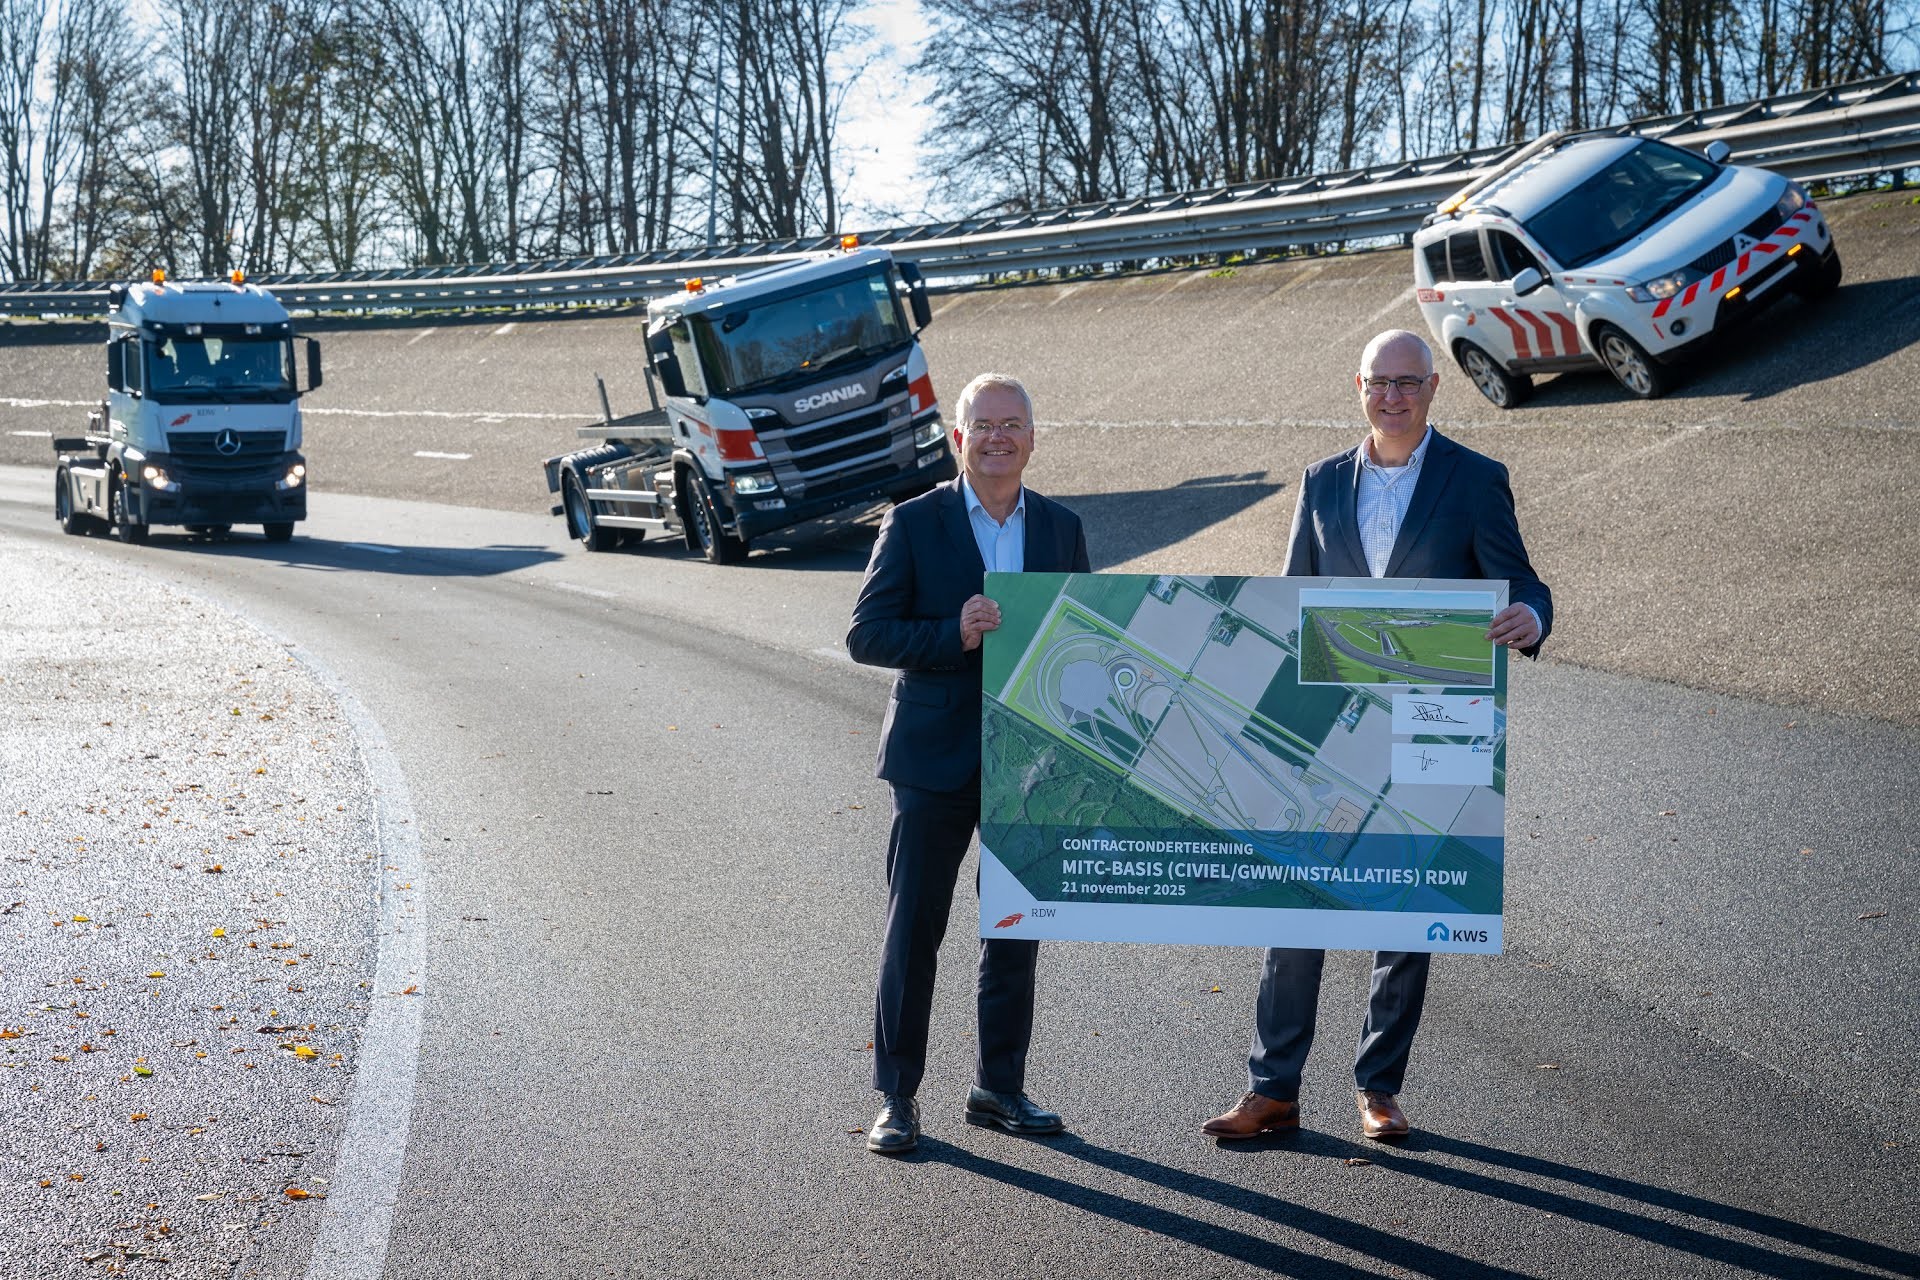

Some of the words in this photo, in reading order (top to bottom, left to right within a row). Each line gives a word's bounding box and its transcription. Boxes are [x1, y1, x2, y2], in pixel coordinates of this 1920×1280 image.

[794, 383, 866, 413] SCANIA
[197, 408, 216, 416] RDW
[1062, 838, 1254, 855] CONTRACTONDERTEKENING
[1062, 859, 1163, 877] MITC-BASIS
[1168, 861, 1420, 888] (CIVIEL/GWW/INSTALLATIES)
[1425, 869, 1468, 886] RDW
[1061, 881, 1078, 893] 21
[1081, 882, 1150, 895] november
[1153, 884, 1186, 896] 2025
[1032, 908, 1056, 917] RDW
[1453, 930, 1488, 943] KWS
